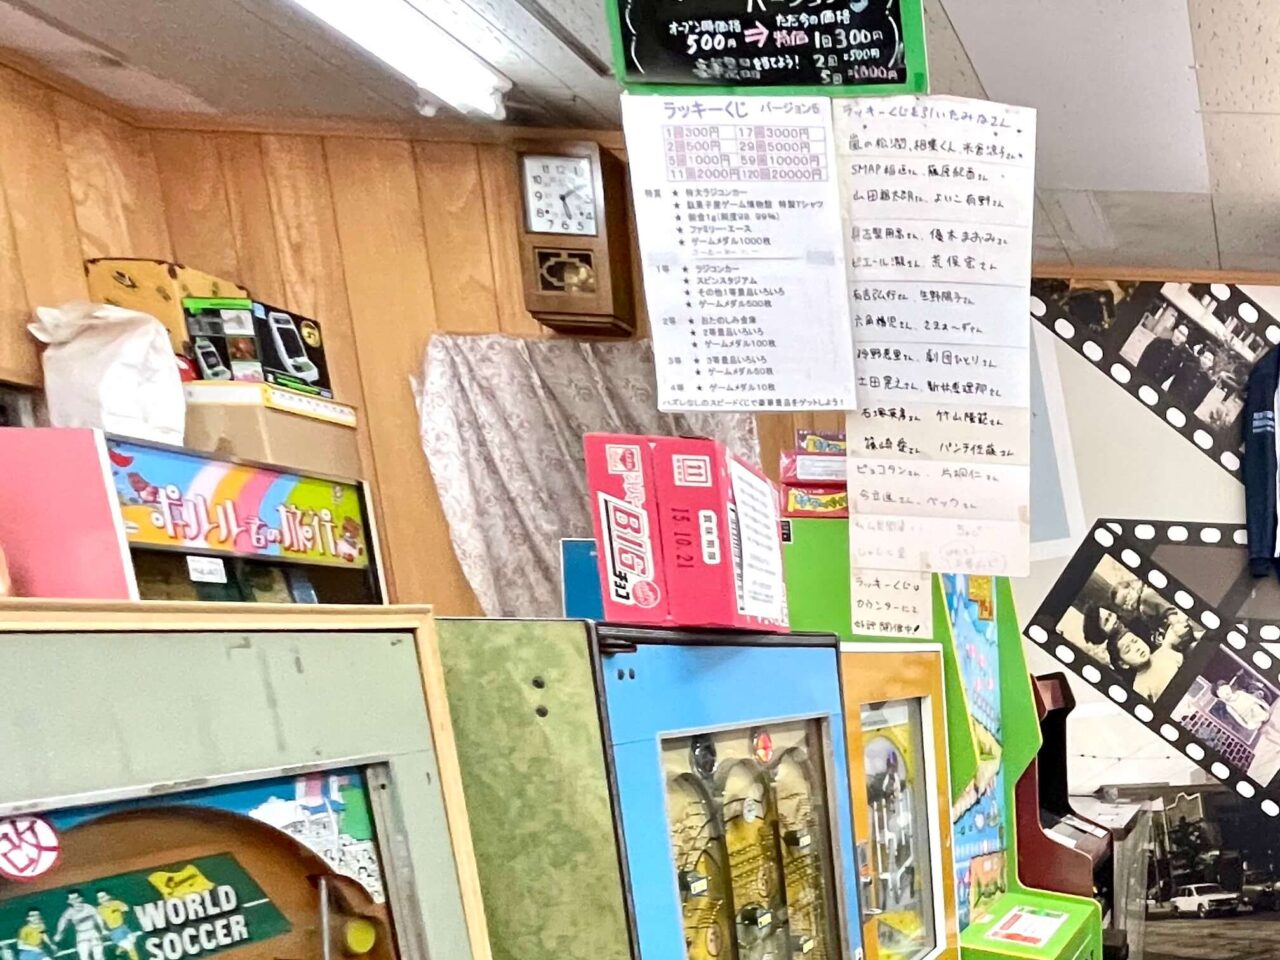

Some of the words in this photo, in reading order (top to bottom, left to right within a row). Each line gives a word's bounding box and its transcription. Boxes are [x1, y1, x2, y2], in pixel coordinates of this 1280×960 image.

[664, 101, 749, 119] ラッキーくじ
[612, 505, 648, 577] BIG
[133, 884, 238, 932] WORLD
